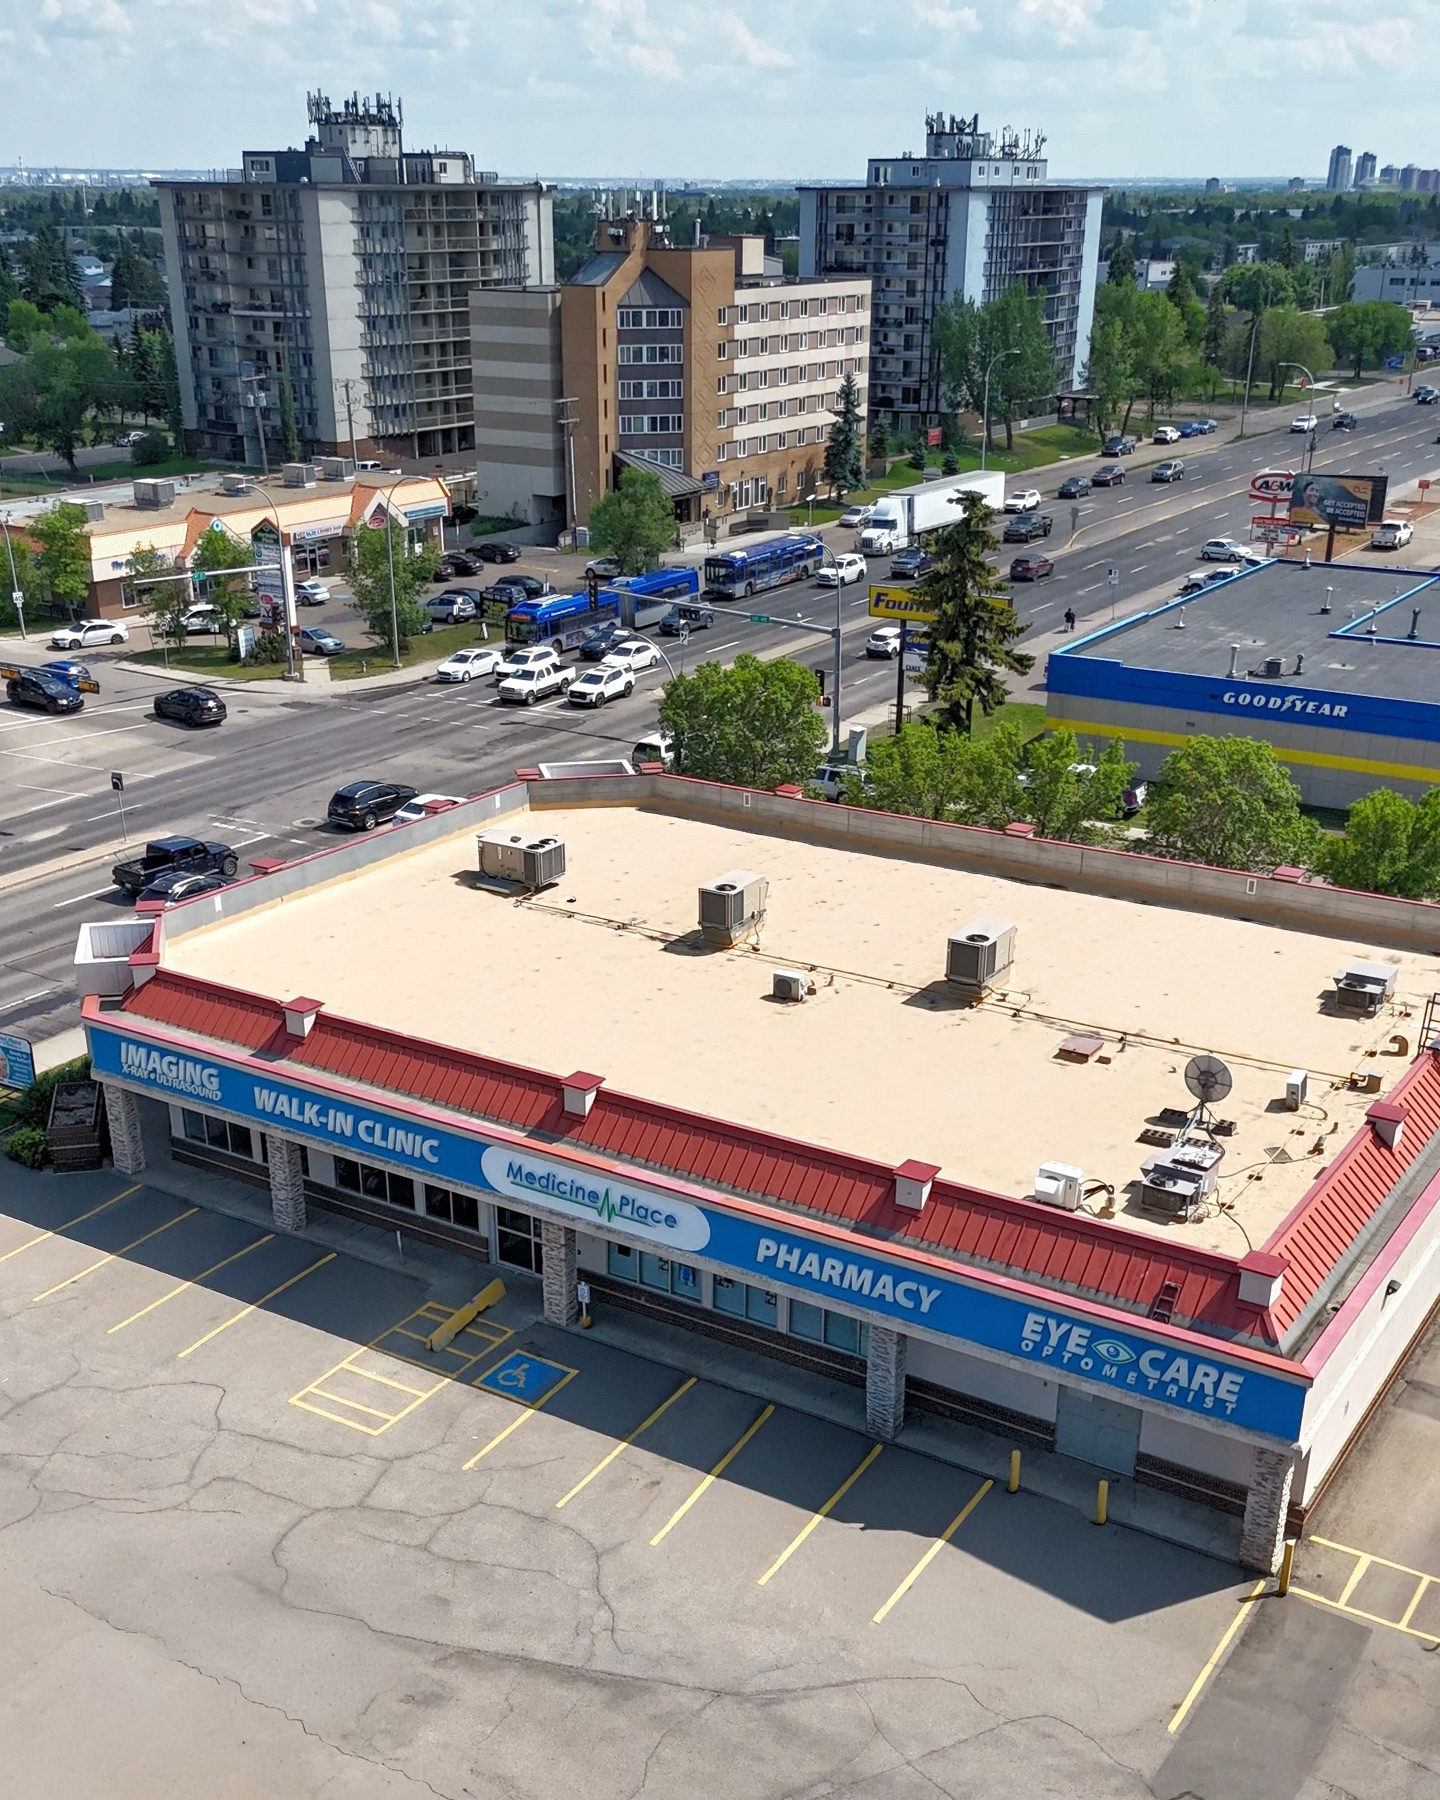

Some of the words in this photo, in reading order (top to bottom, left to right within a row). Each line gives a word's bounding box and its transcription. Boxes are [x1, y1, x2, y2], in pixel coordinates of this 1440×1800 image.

[1258, 480, 1294, 493] A&W
[1323, 499, 1335, 507] GET
[1335, 508, 1365, 519] ACCEPTED.
[1223, 692, 1347, 717] GOODYEAR
[120, 1041, 220, 1091] IMAGING
[121, 1063, 149, 1079] X-RAY
[156, 1074, 222, 1102] ULTRASOUND
[253, 1086, 353, 1137] WALK-IN
[358, 1119, 440, 1164] CLINIC
[507, 1161, 599, 1202] Medicine
[619, 1195, 677, 1229] Place
[756, 1237, 942, 1314] PHARMACY
[1020, 1340, 1238, 1416] OPTOMETRIST
[1021, 1312, 1091, 1354] EYE
[1139, 1349, 1245, 1404] CARE
